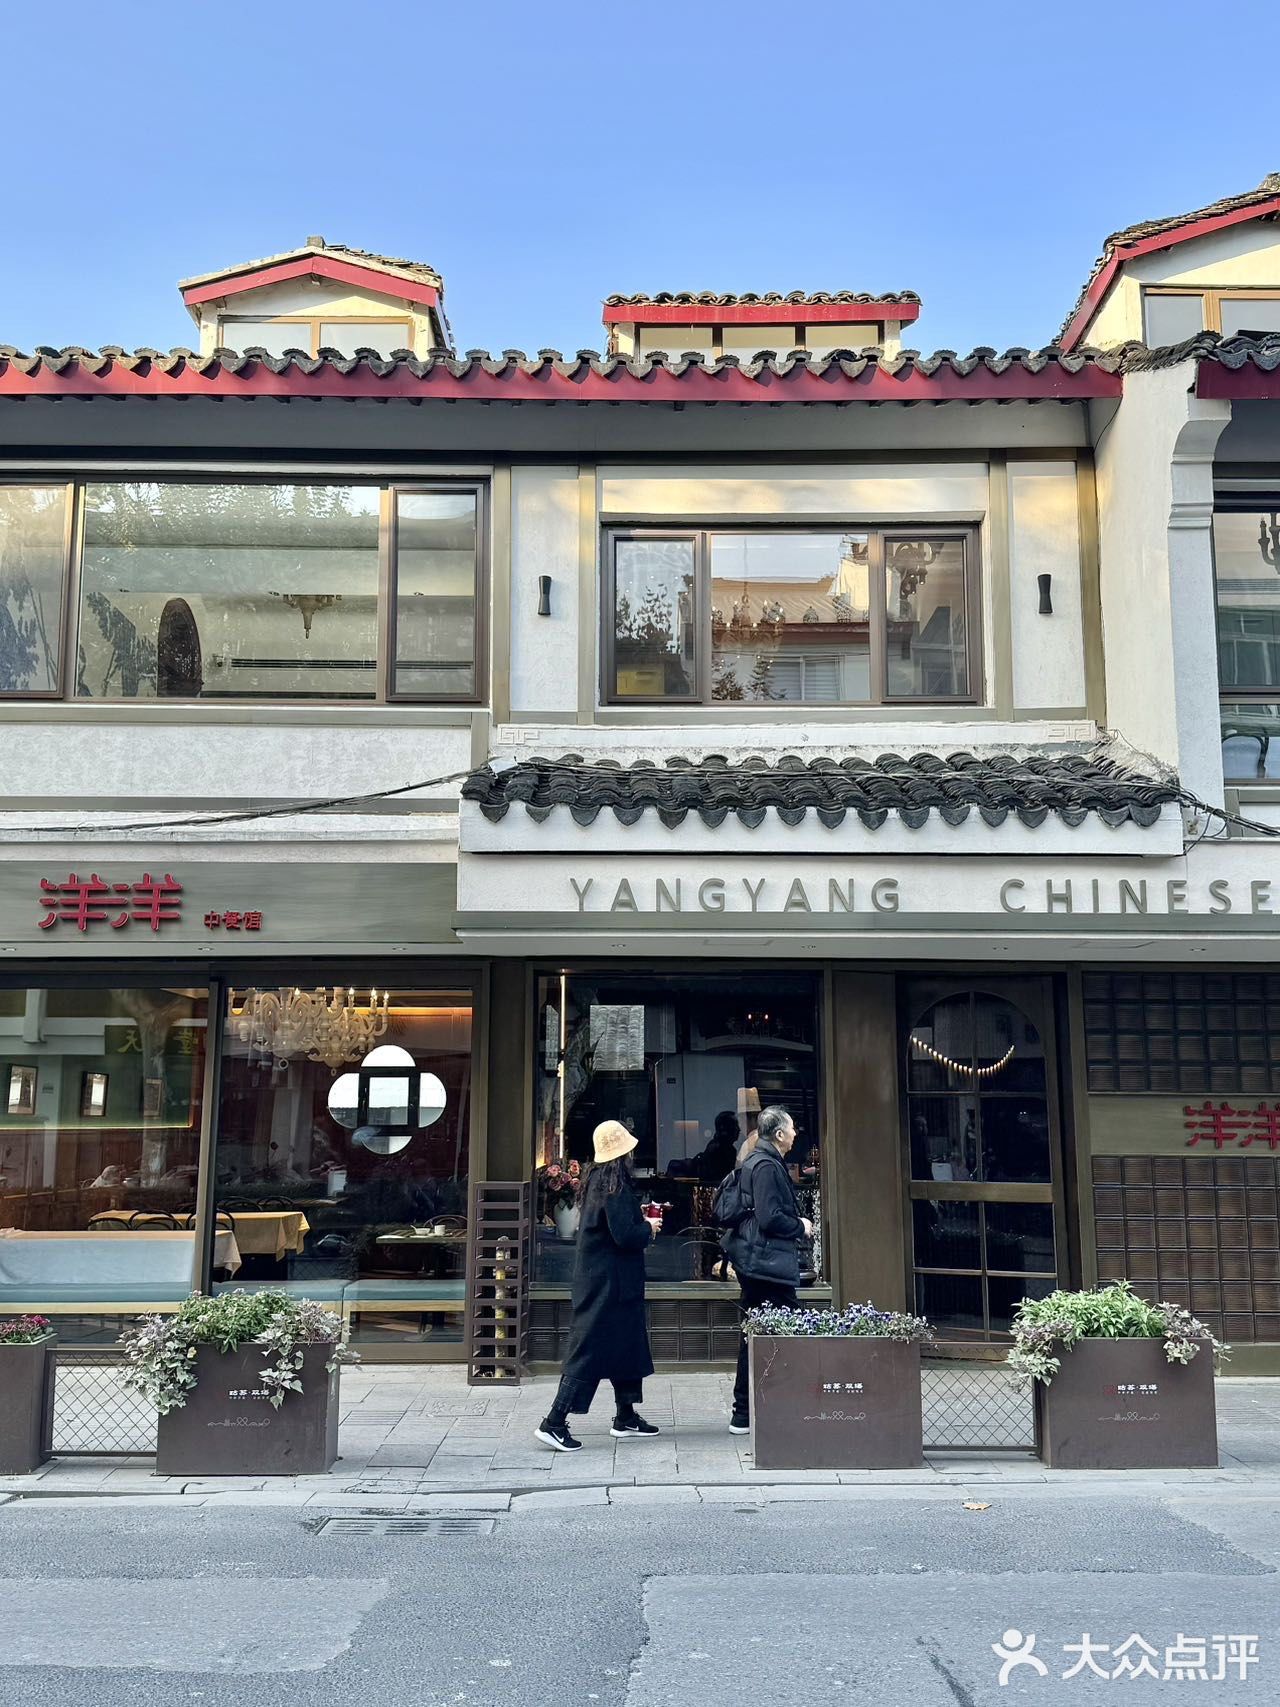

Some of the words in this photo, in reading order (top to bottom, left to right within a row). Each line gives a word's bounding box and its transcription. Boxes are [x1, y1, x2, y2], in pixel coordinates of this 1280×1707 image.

[38, 873, 183, 931] 洋洋
[203, 910, 264, 931] 中餐馆
[570, 878, 899, 913] YANGYANG
[1000, 879, 1273, 916] CHINESE
